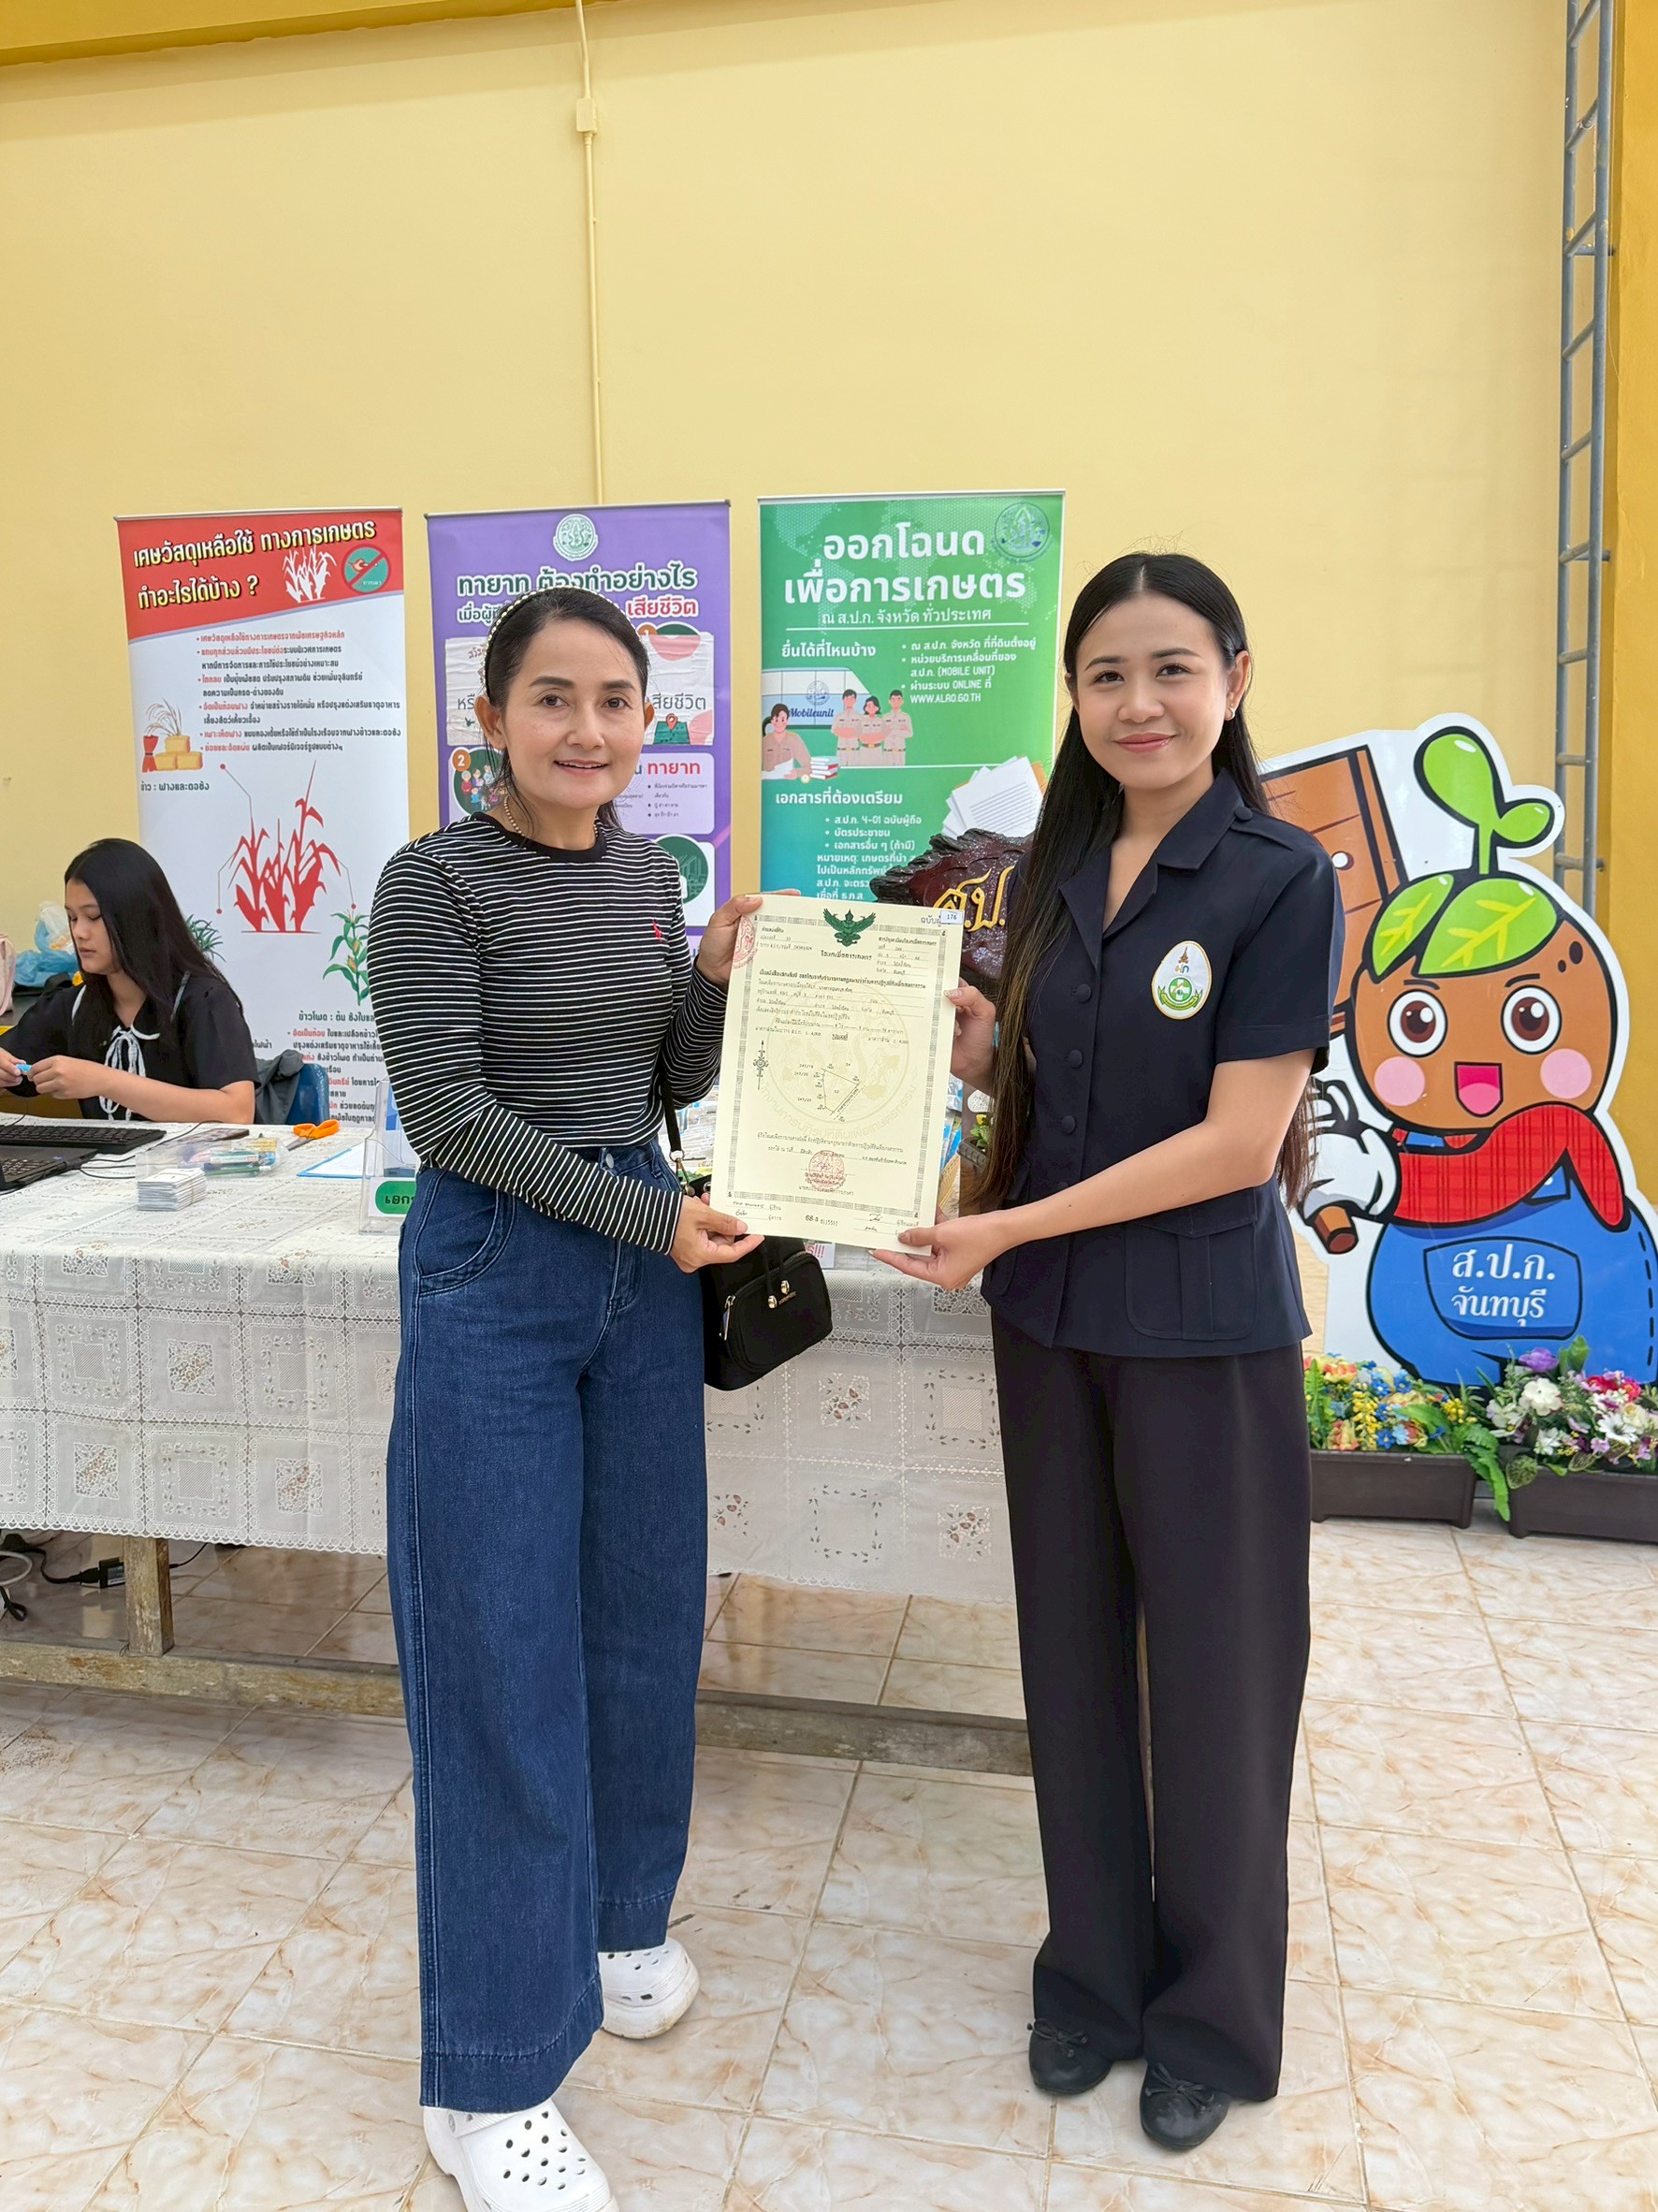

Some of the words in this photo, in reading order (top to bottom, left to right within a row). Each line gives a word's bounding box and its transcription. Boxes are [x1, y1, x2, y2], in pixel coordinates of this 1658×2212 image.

[133, 528, 255, 568] เศษวัสดุเหลือใช้
[259, 519, 376, 554] ทางการเกษตร
[823, 522, 985, 560] ออกโฉนด
[458, 573, 530, 597] ทายาท
[538, 560, 697, 592] ต้องทำอย่างไร
[784, 559, 1026, 604] เพื่อการเกษตร
[137, 575, 241, 610] ทำอะไรได้บ้าง
[246, 575, 260, 597] ?
[627, 597, 697, 618] เสียชีวิต
[822, 613, 835, 624] ณ
[837, 611, 874, 625] ส.ป.ก.
[877, 609, 920, 624] จังหวัด
[923, 604, 992, 622] ทั่วประเทศ
[781, 641, 877, 659] ยื่นได้ที่ไหนบ้าง
[910, 643, 921, 651] ณ
[951, 639, 981, 649] จังหวัด
[983, 635, 1037, 650] ที่ที่ดินตั้งอยู่
[910, 648, 1017, 664] หน่วยบริการเคลื่อนที่ของ
[938, 665, 970, 677] (MOBILE
[972, 664, 996, 677] UNIT)
[909, 679, 950, 691] ผ่านระบบ
[952, 679, 982, 690] ONLINE
[649, 694, 706, 710] สียชีวิต
[909, 693, 982, 704] WWW.ALRO.GO.TH
[458, 753, 465, 767] 2
[647, 763, 701, 775] ทายาท
[775, 786, 903, 805] เอกสารที่ต้องเตรียม
[861, 815, 881, 824] 4-01
[883, 814, 923, 827] ฉบับผู้ถือ
[834, 827, 891, 837] บัตรประชาชน
[834, 837, 879, 850] เอกสารอื่น
[890, 839, 915, 851] (ถ้ามี)
[298, 1011, 327, 1021] ข้าวโพด
[1451, 1243, 1556, 1280] ส.ป.ก.
[1450, 1286, 1547, 1327] จันทบุรี
